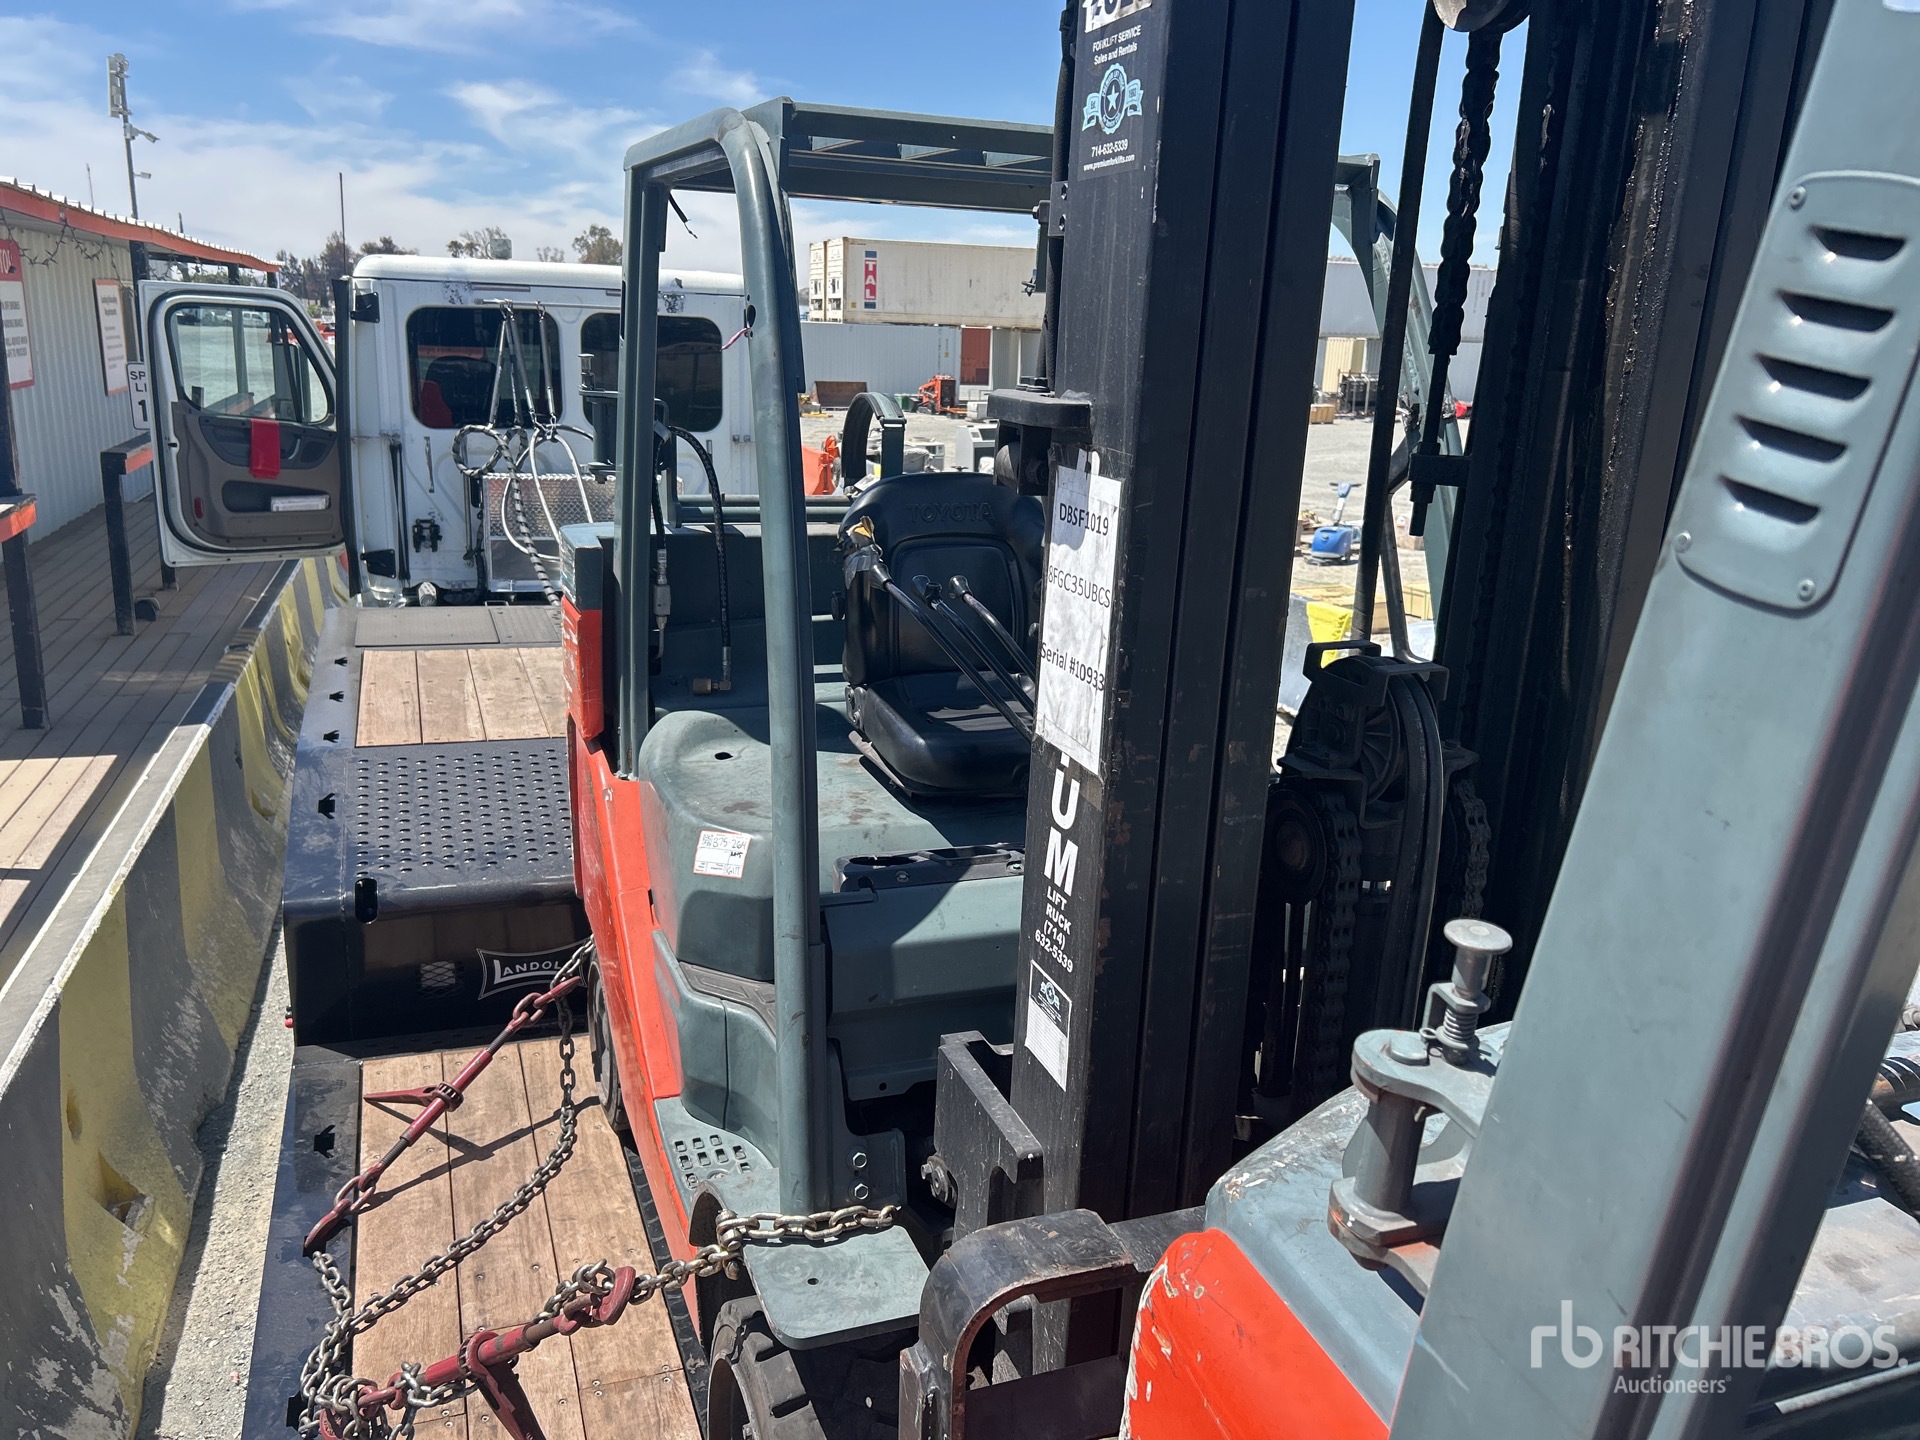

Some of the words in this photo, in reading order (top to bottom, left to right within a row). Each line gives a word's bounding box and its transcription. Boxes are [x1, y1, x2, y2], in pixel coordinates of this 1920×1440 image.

[1117, 25, 1142, 43] SERVICE
[1094, 53, 1108, 66] Sales
[1108, 48, 1119, 60] and
[1118, 42, 1138, 57] Rentals
[1091, 138, 1129, 158] 714-632-5339
[865, 261, 877, 299] TAL
[130, 371, 146, 380] SP
[135, 383, 147, 392] LI
[138, 399, 148, 422] 1
[906, 502, 995, 522] TOYOTA
[1059, 503, 1109, 536] DBSF1019
[1048, 565, 1111, 608] 8FGC35UBCS
[1041, 642, 1067, 671] Serial
[1069, 656, 1105, 691] #10933
[1044, 752, 1080, 897] UM
[1046, 885, 1067, 911] LIFT
[1045, 902, 1072, 935] RUCK
[1043, 919, 1066, 950] (714)
[1035, 929, 1073, 973] 632-5339
[493, 959, 564, 985] LANDOL
